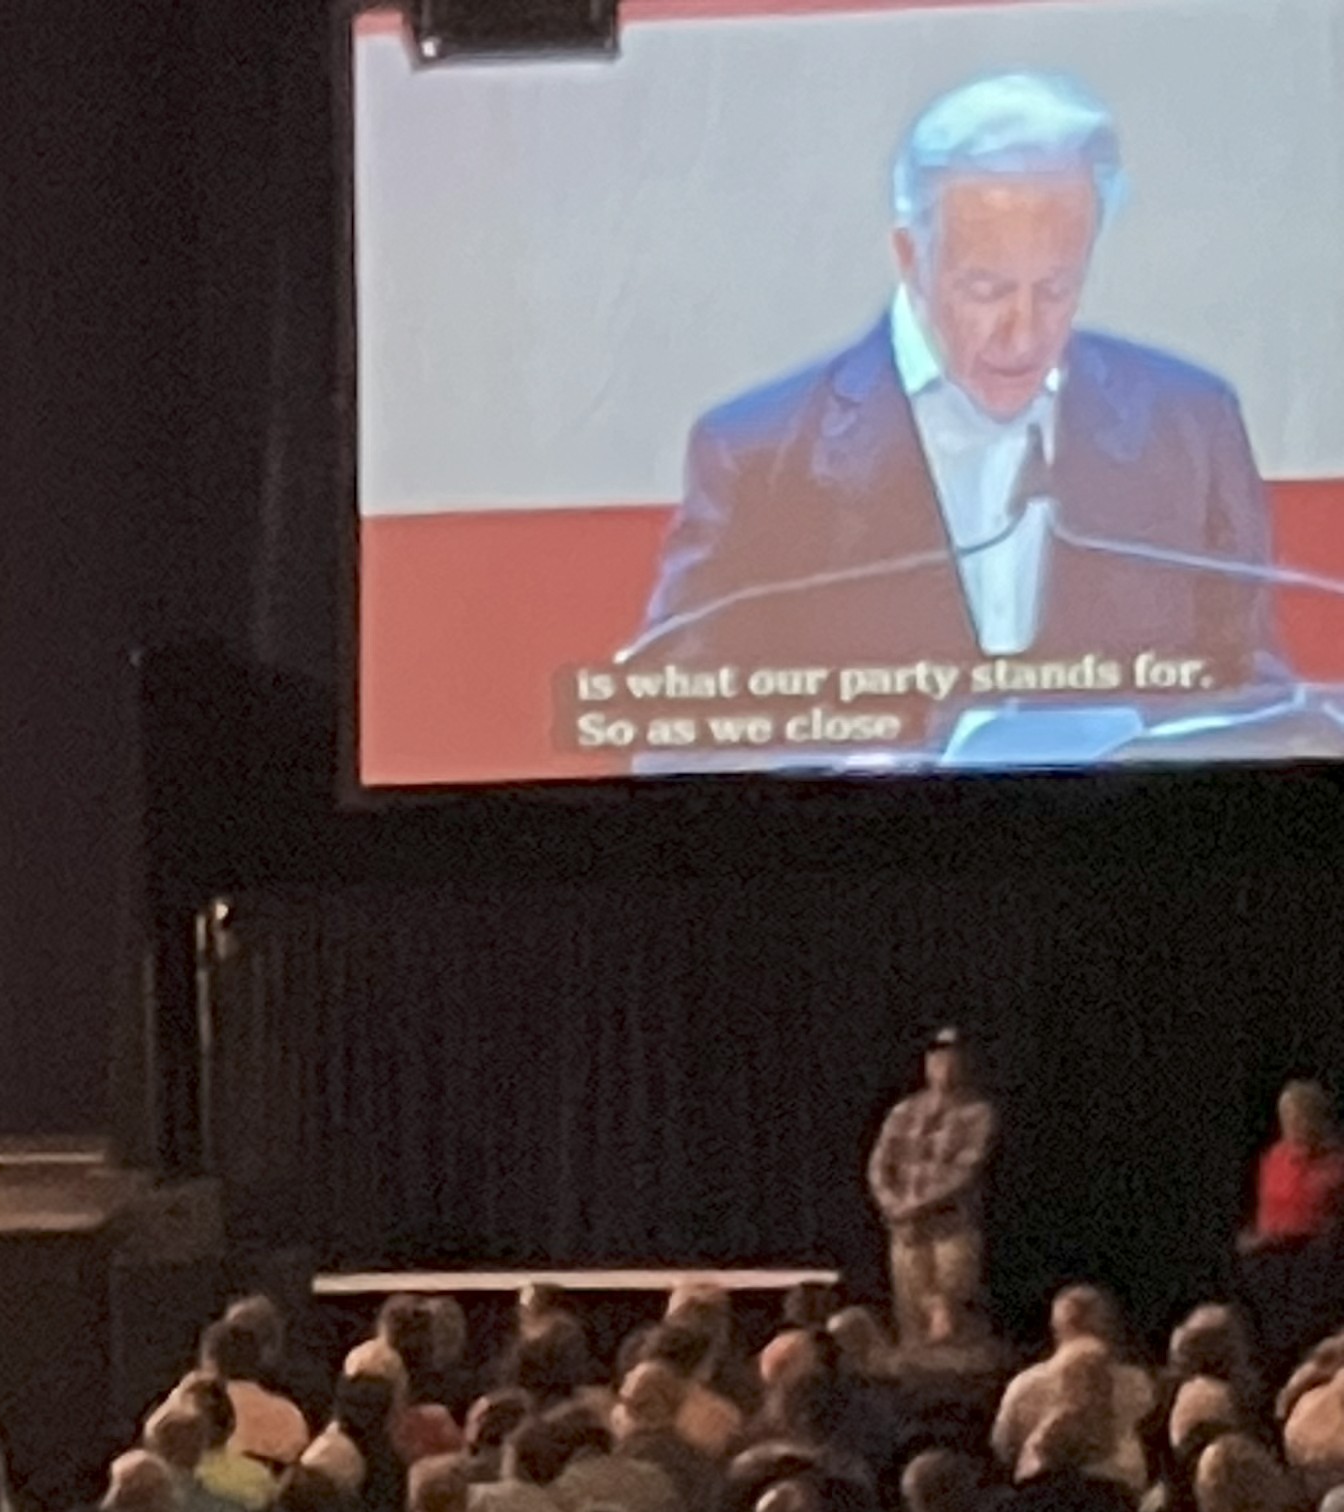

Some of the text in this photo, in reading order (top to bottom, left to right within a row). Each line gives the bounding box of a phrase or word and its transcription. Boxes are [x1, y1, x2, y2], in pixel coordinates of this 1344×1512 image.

[626, 664, 736, 699] what
[747, 668, 831, 696] our
[839, 660, 959, 702] party
[970, 653, 1121, 692] stands
[1134, 651, 1215, 690] for.
[576, 706, 901, 746] So as we close
